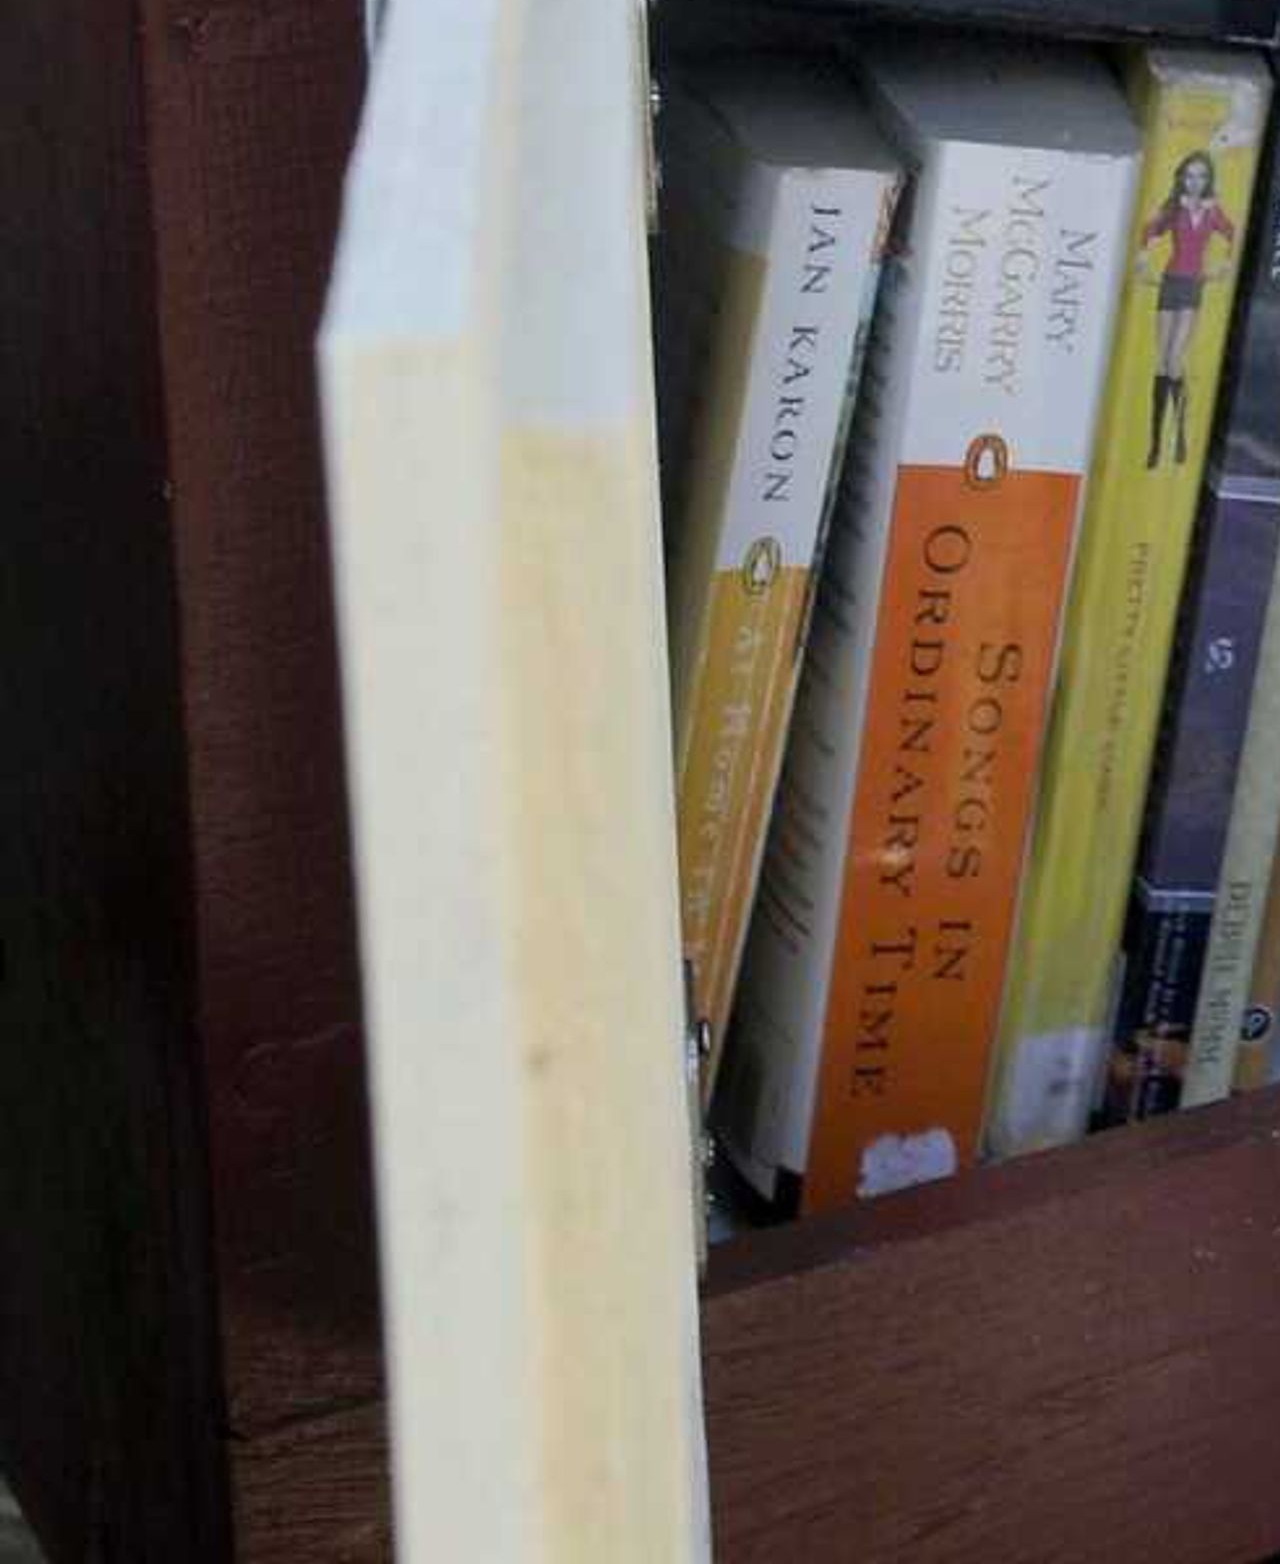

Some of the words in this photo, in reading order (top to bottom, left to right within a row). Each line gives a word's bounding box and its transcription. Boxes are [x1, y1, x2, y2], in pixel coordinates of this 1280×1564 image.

[800, 203, 841, 294] JAN
[933, 206, 991, 373] MORRIS
[762, 325, 819, 503] KARON
[877, 524, 973, 899] ORDINARY
[945, 641, 1024, 881] SONGS
[850, 925, 918, 1101] TIME
[933, 918, 973, 983] IN
